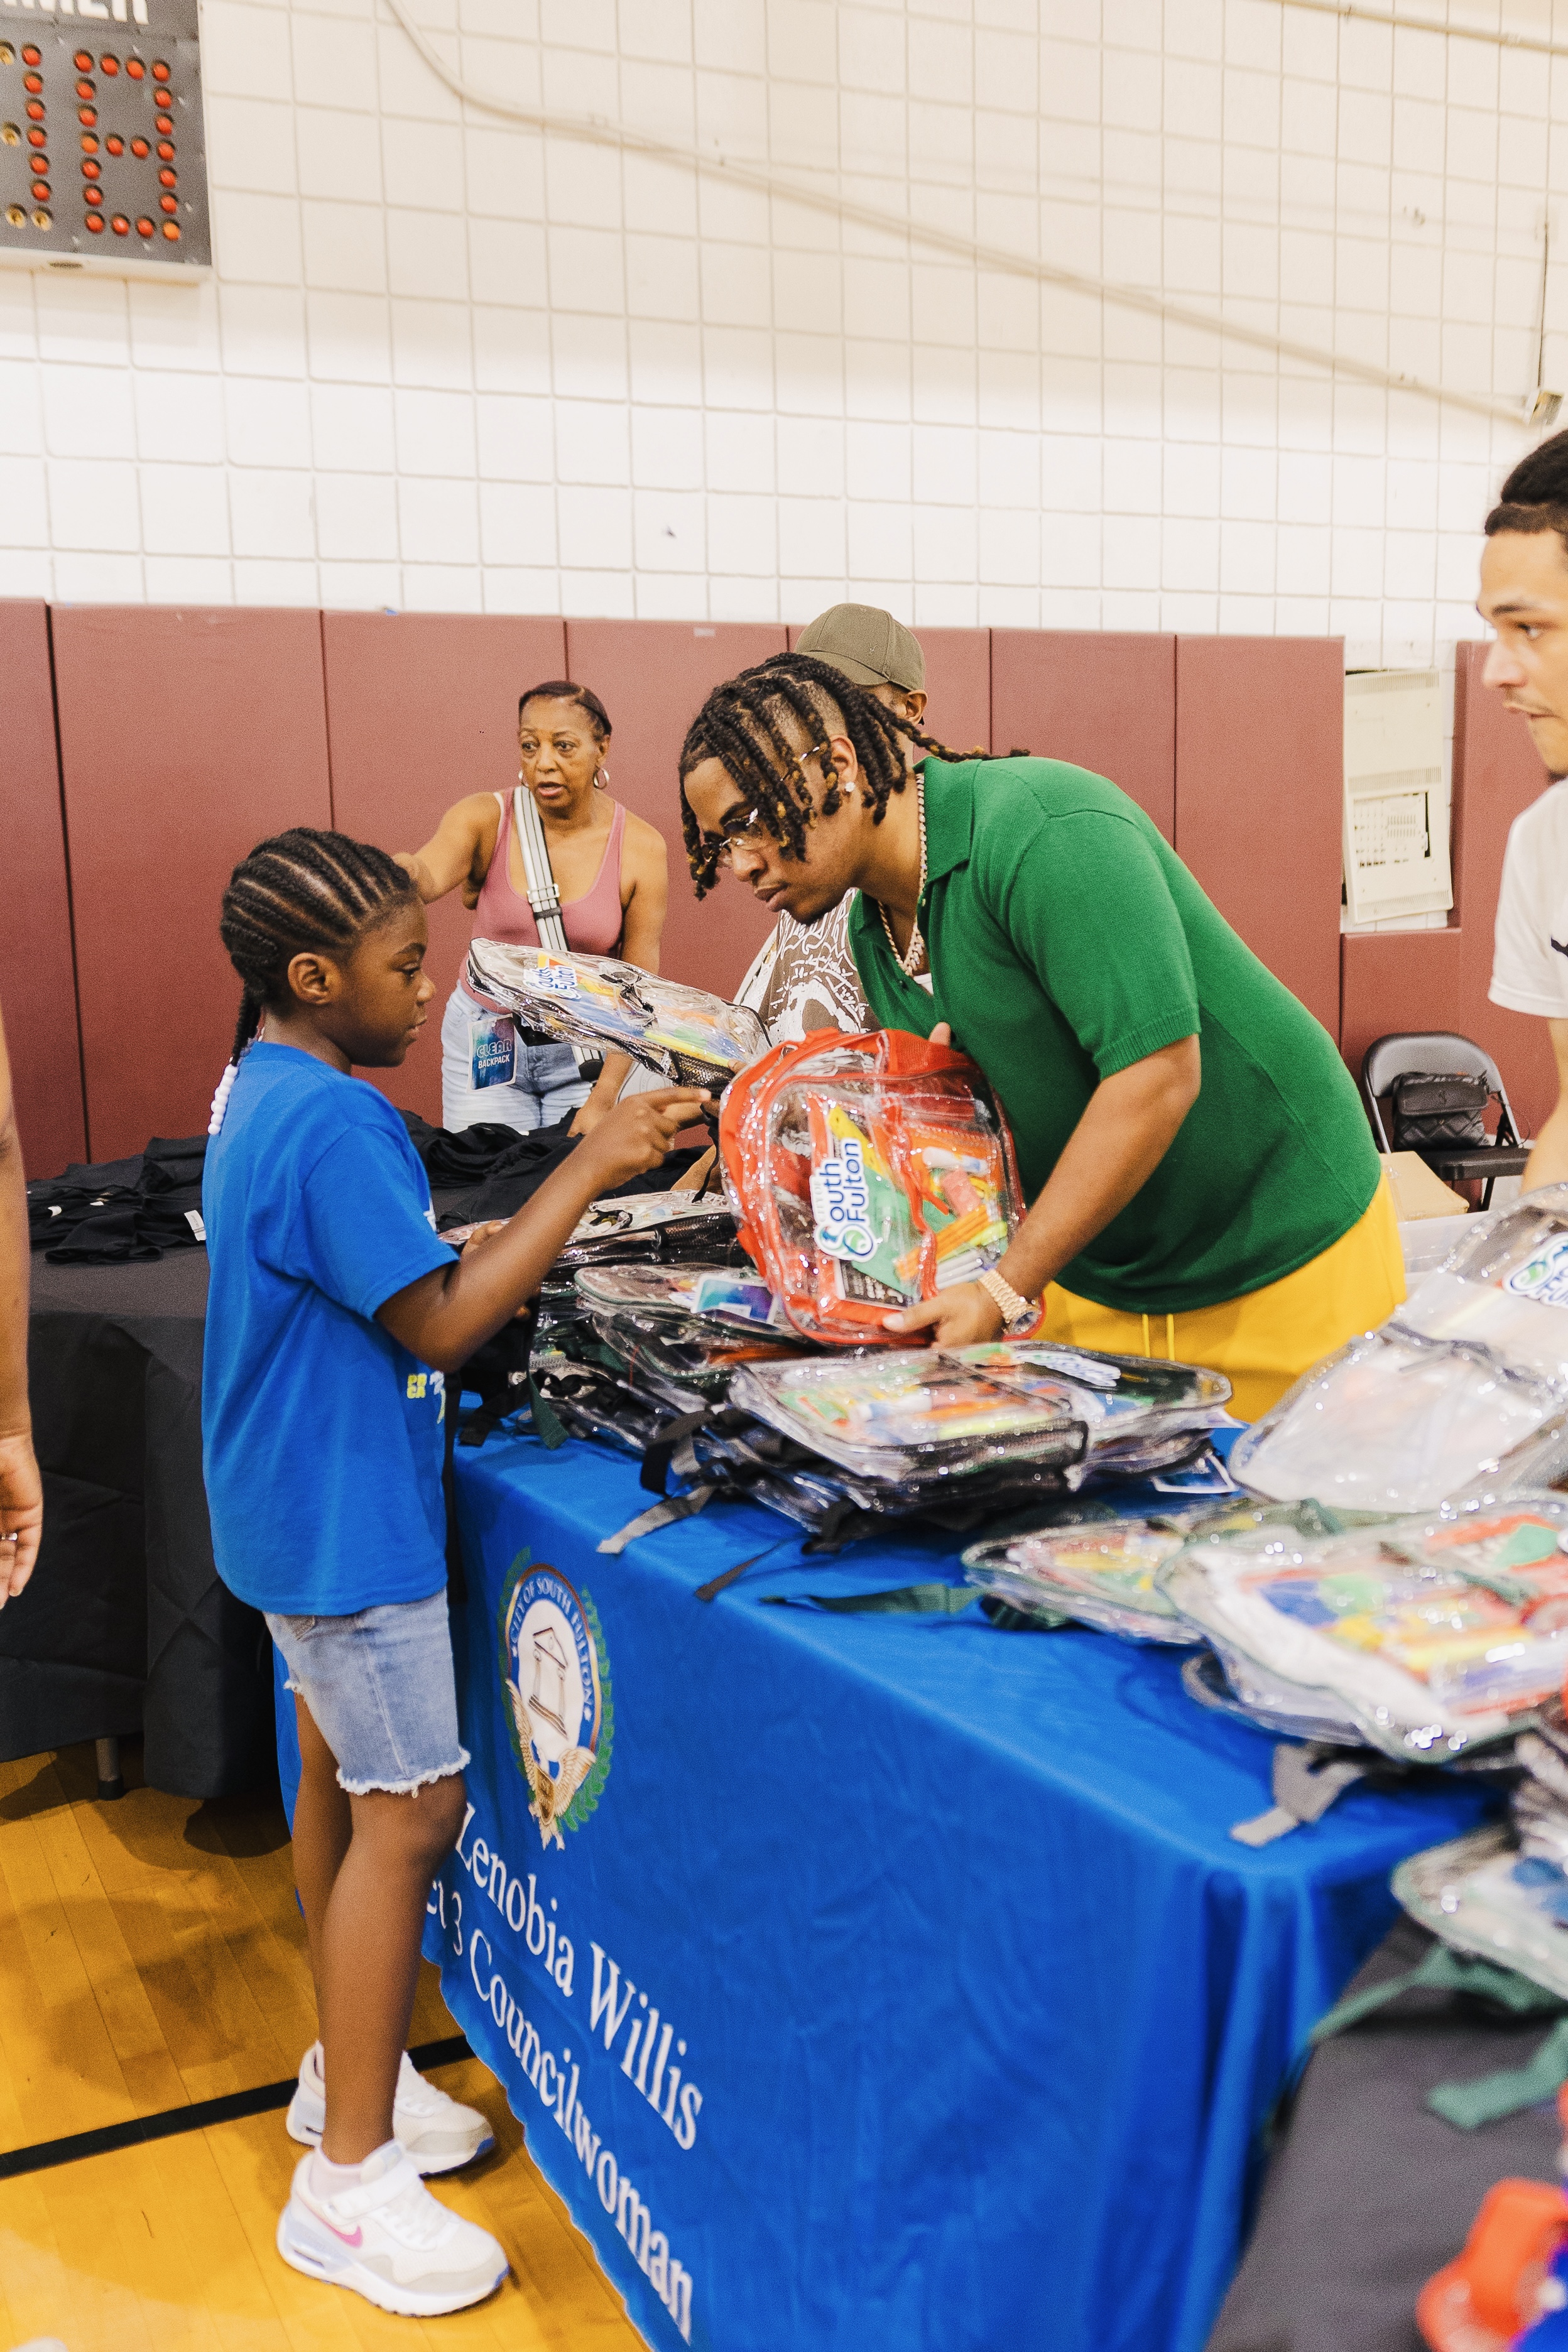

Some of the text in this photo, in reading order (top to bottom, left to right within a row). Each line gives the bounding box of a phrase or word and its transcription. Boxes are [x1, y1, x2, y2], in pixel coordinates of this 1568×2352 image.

[477, 1038, 512, 1059] CLEAR
[478, 1054, 510, 1069] BACKPACK
[843, 1141, 866, 1222] Fulton
[510, 1577, 592, 1705] CITY OF SOUTH FULTON
[590, 1940, 704, 2150] Willis
[470, 1927, 694, 2346] Councilwoman
